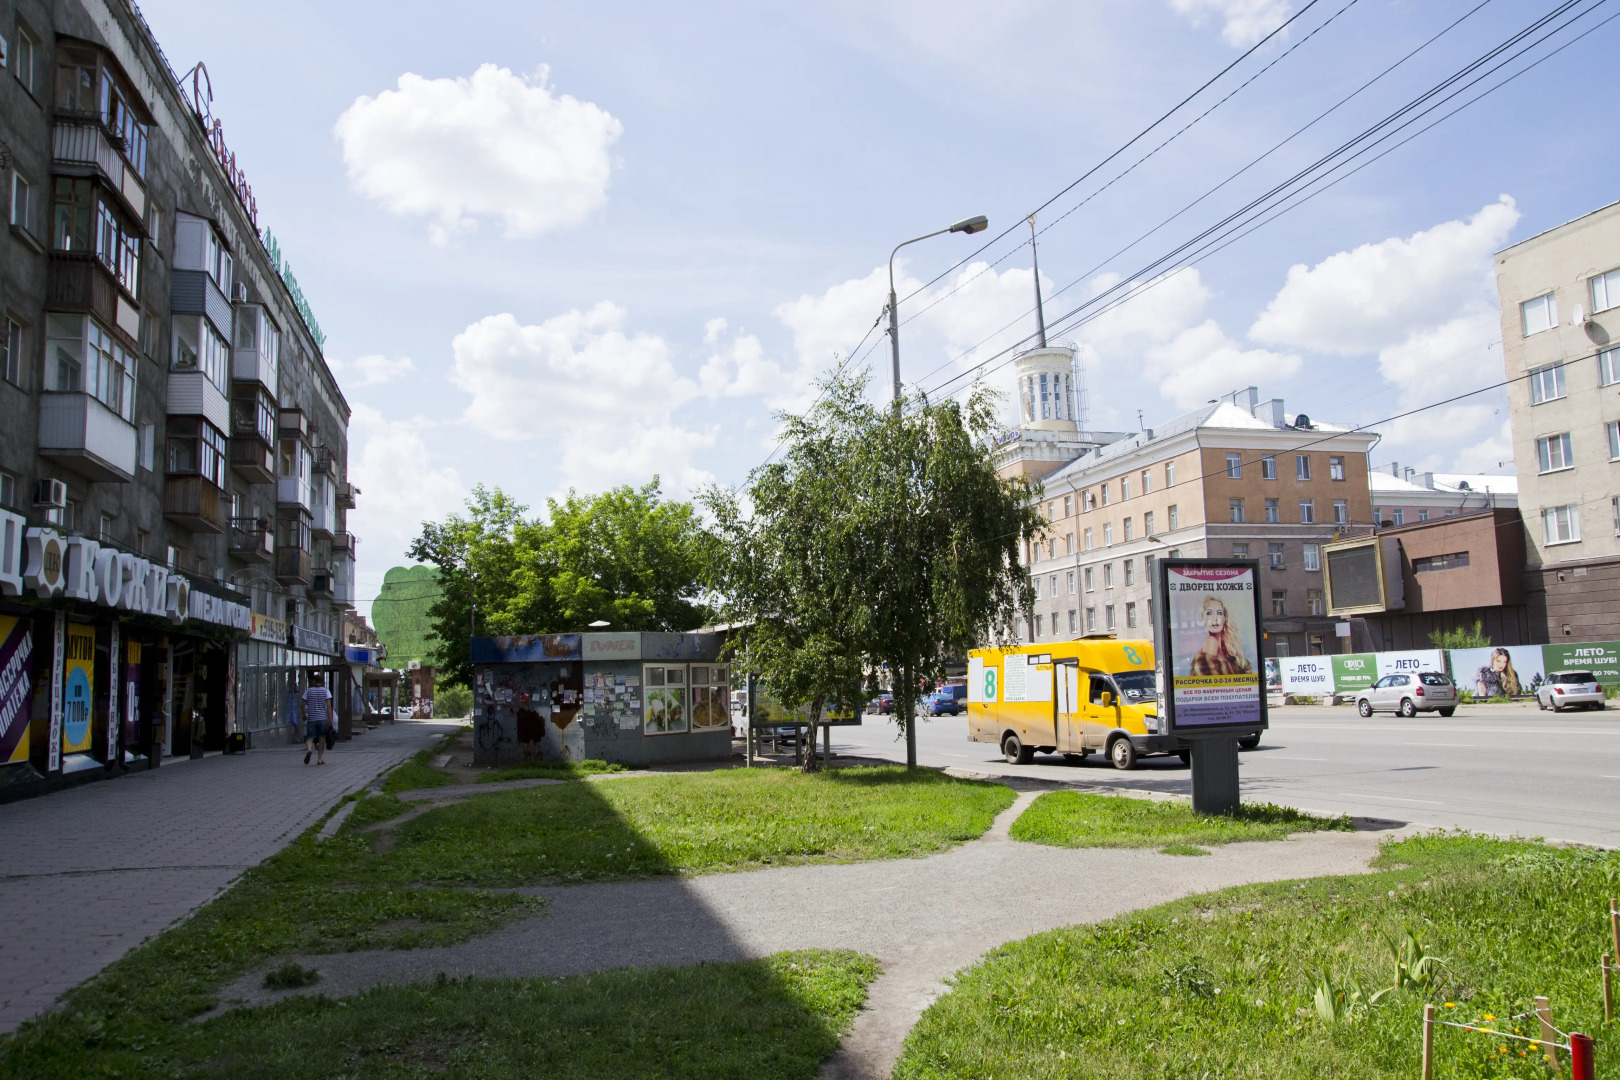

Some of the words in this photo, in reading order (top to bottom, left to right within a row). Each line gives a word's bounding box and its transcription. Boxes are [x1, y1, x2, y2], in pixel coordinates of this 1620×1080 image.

[65, 536, 169, 617] КОЖИ
[1179, 583, 1214, 592] ДВОРЕЦ
[1216, 583, 1244, 591] КОЖИ
[68, 634, 93, 661] МУТОН
[1574, 647, 1604, 657] ЛЕТО
[1123, 646, 1142, 665] 8
[1395, 659, 1420, 669] ЛЕТО
[1564, 658, 1592, 666] ВРЕМЯ
[1297, 664, 1317, 673] ЛЕТО
[1175, 678, 1213, 686] РАССРОЧКА
[1290, 675, 1310, 683] ВРЕМЯ
[1311, 675, 1326, 683] ШУБ!
[985, 670, 996, 699] 8
